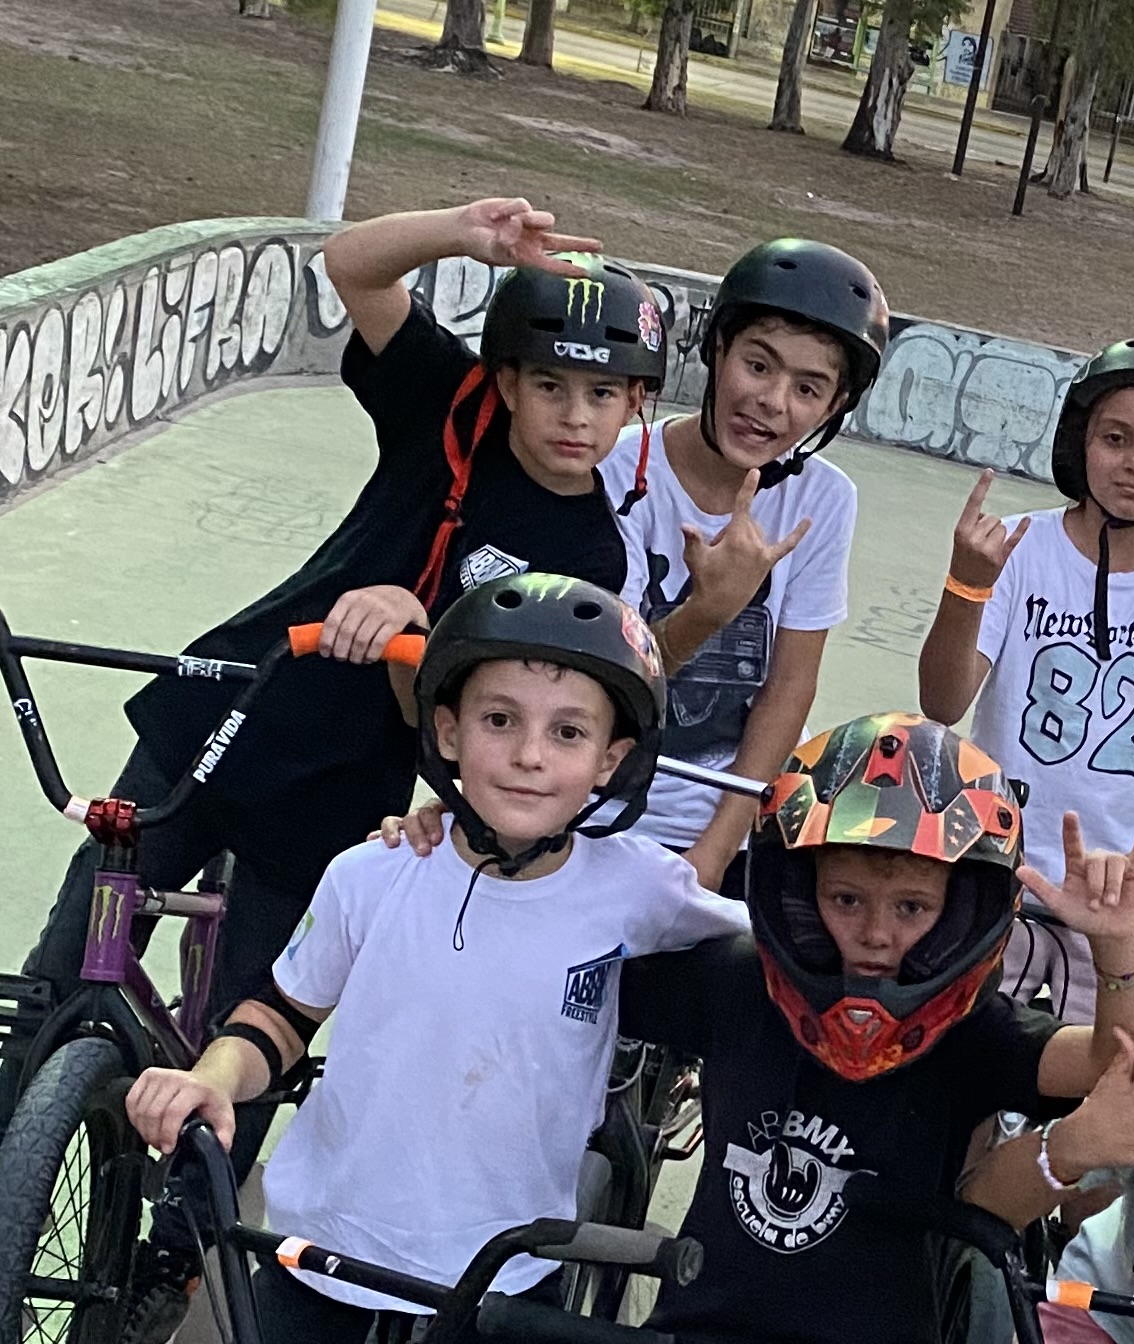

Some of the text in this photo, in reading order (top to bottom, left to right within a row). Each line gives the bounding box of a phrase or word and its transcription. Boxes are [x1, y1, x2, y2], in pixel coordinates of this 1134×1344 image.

[1024, 593, 1084, 641] New
[733, 1176, 779, 1244] escuela
[784, 1227, 809, 1248] de
